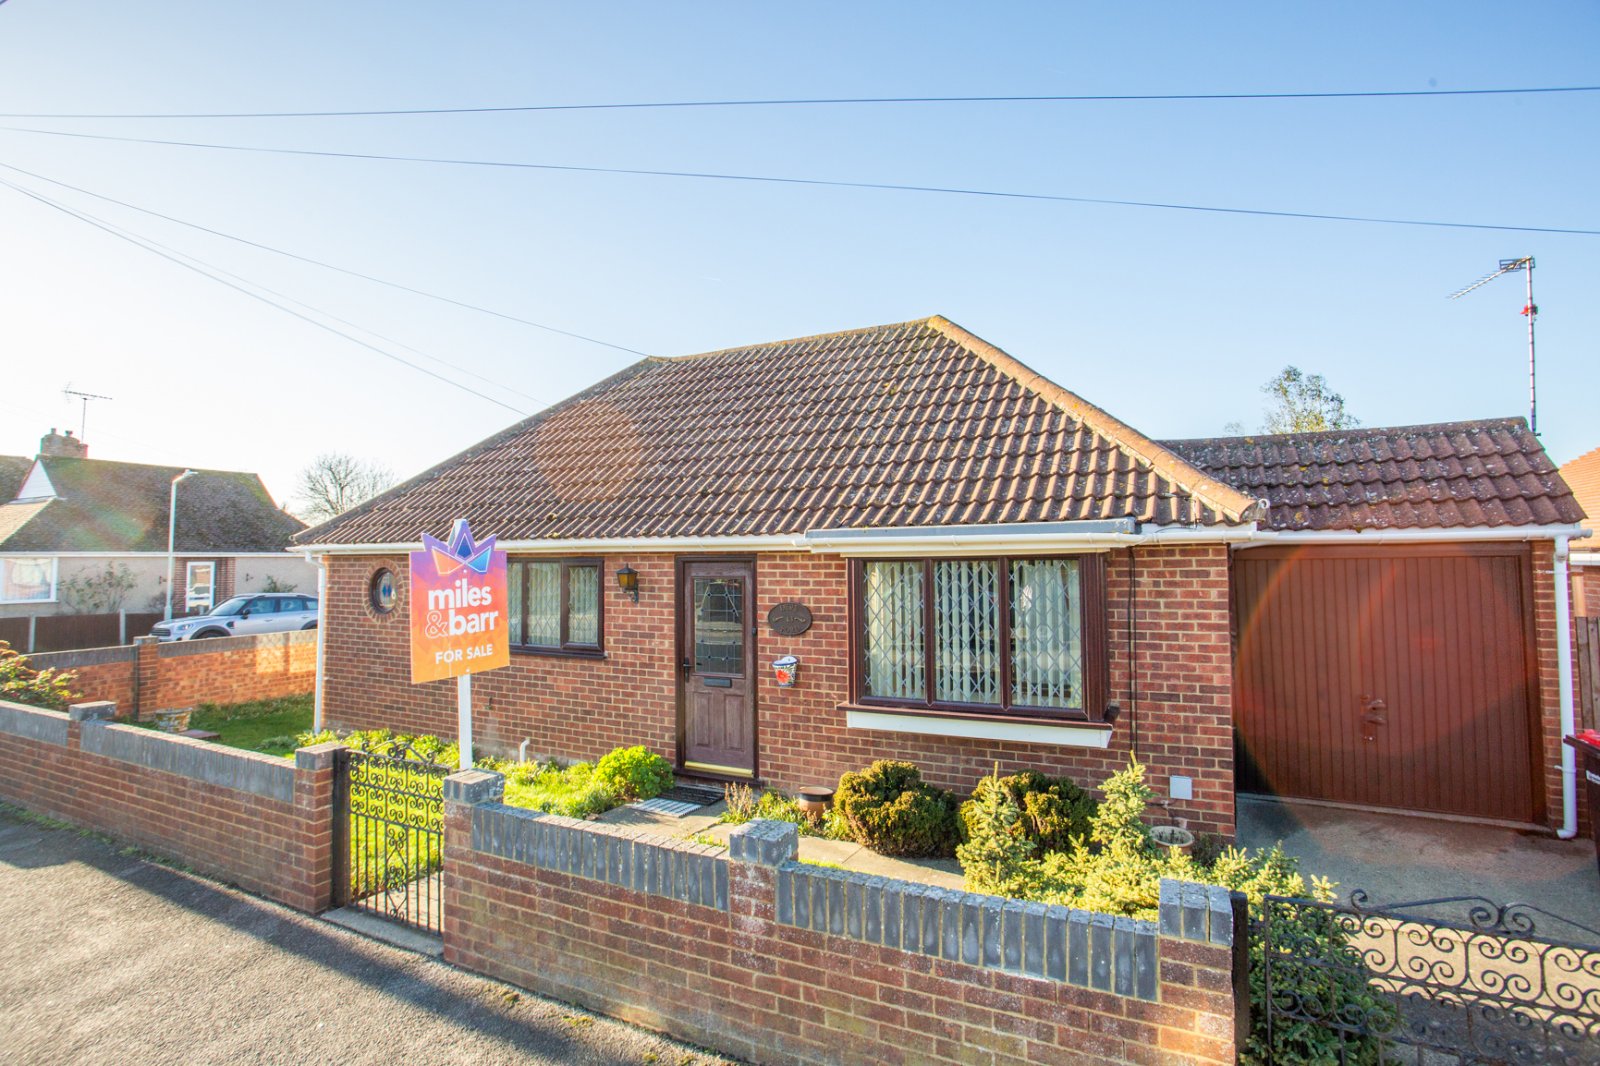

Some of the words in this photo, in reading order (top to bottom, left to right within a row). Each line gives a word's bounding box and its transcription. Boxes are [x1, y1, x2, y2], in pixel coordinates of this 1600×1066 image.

[428, 578, 492, 610] miles
[435, 649, 463, 665] FOR
[467, 644, 493, 660] SALE
